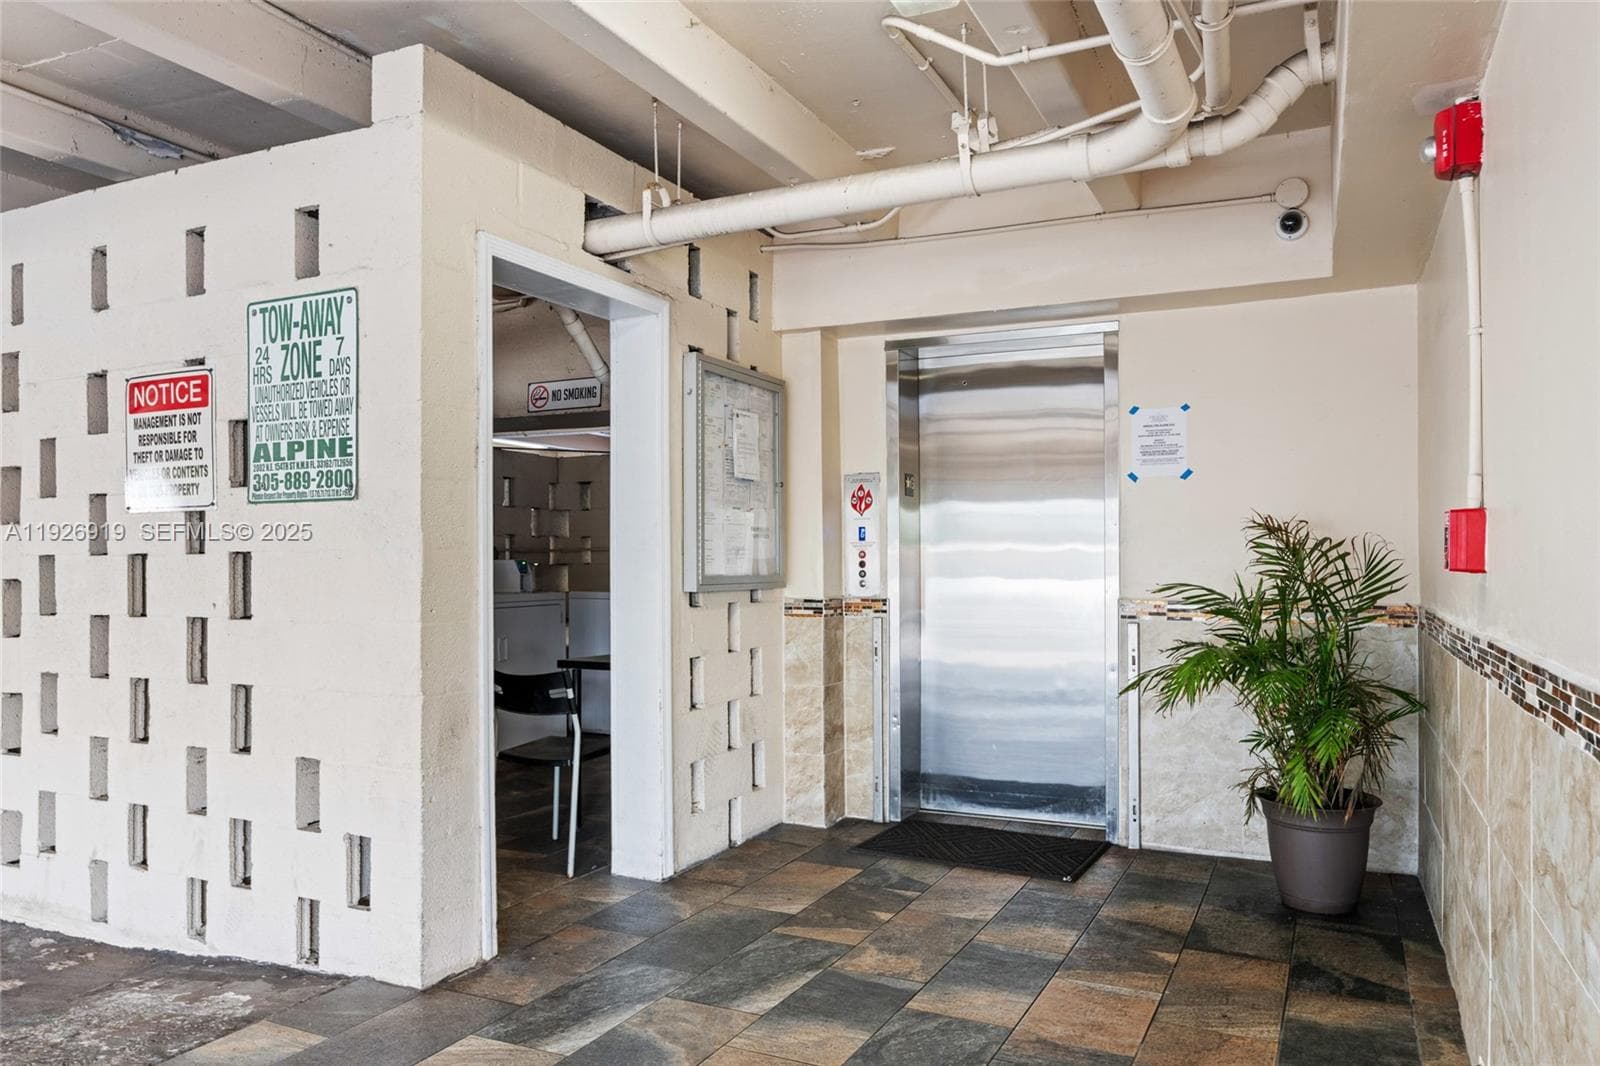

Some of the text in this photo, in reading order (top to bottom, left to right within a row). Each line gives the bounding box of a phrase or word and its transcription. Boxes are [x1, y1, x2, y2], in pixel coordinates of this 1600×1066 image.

[259, 296, 344, 344] TOW-AWAY
[255, 346, 270, 365] 24
[336, 336, 344, 356] 7
[280, 340, 322, 382] ZONE
[329, 356, 351, 376] DAYS
[253, 366, 272, 385] HRS
[133, 380, 202, 408] NOTICE
[255, 377, 350, 404] UNAUTHORIZED VEHICLES OR
[552, 386, 597, 401] NO SMOKING
[252, 397, 354, 423] VESSELS WILL BE TOWED AWAY
[133, 412, 202, 430] MANAGEMENT IS NOT
[256, 418, 350, 442] AT OWNERS RISK & EXPENSE
[138, 430, 197, 447] RESPONSIBLE FOR
[133, 447, 204, 464] THEFT OR DAMAGE TO
[252, 436, 354, 463] ALPINE
[161, 466, 171, 479] OR
[172, 464, 209, 478] CONTENTS
[253, 468, 354, 492] 305-889-2800
